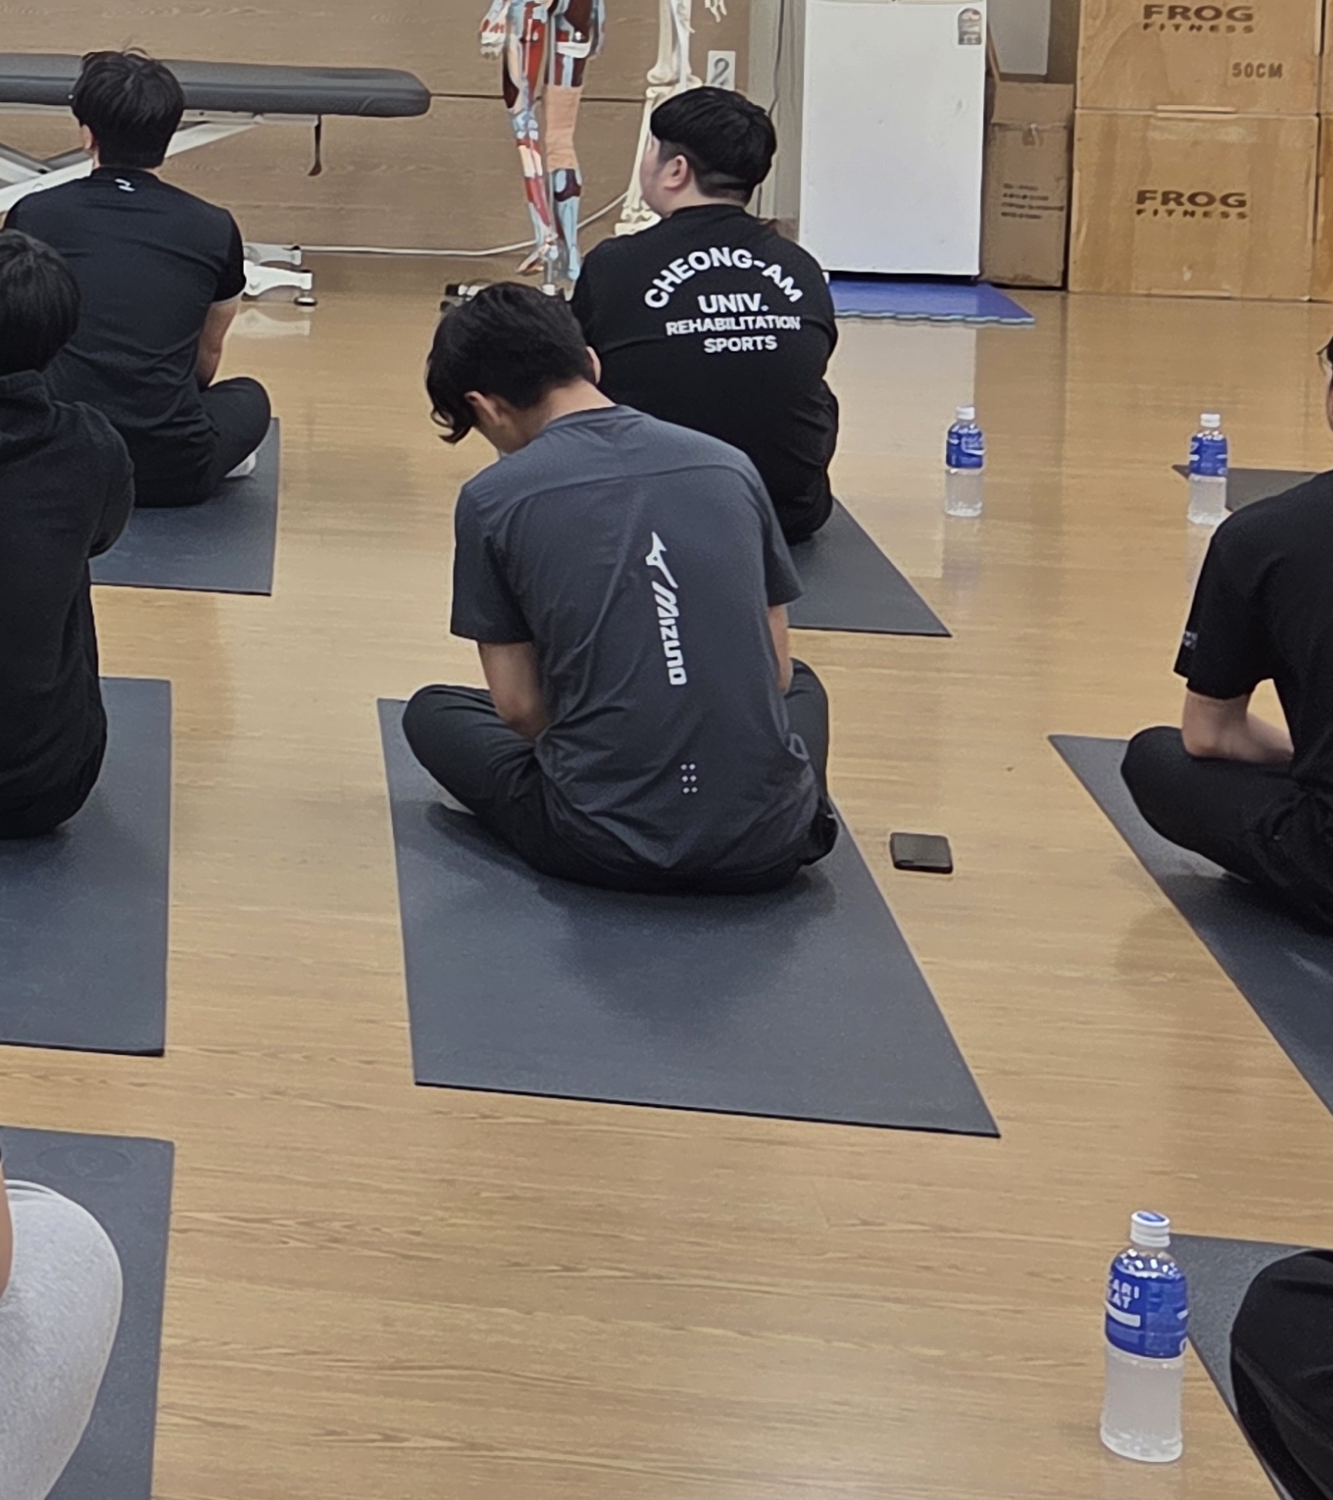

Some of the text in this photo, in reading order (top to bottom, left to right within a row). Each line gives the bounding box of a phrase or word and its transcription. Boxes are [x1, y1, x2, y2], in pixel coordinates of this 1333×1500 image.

[1143, 4, 1254, 22] FROG
[1142, 22, 1254, 34] FITNESS
[1231, 62, 1283, 79] 50CM
[1135, 189, 1247, 209] FROG
[1135, 208, 1247, 220] FITNESS
[644, 247, 803, 309] CHEONG-AM
[697, 293, 769, 314] UNIV.
[665, 315, 801, 336] REHABILITATION
[704, 335, 778, 353] SPORTS
